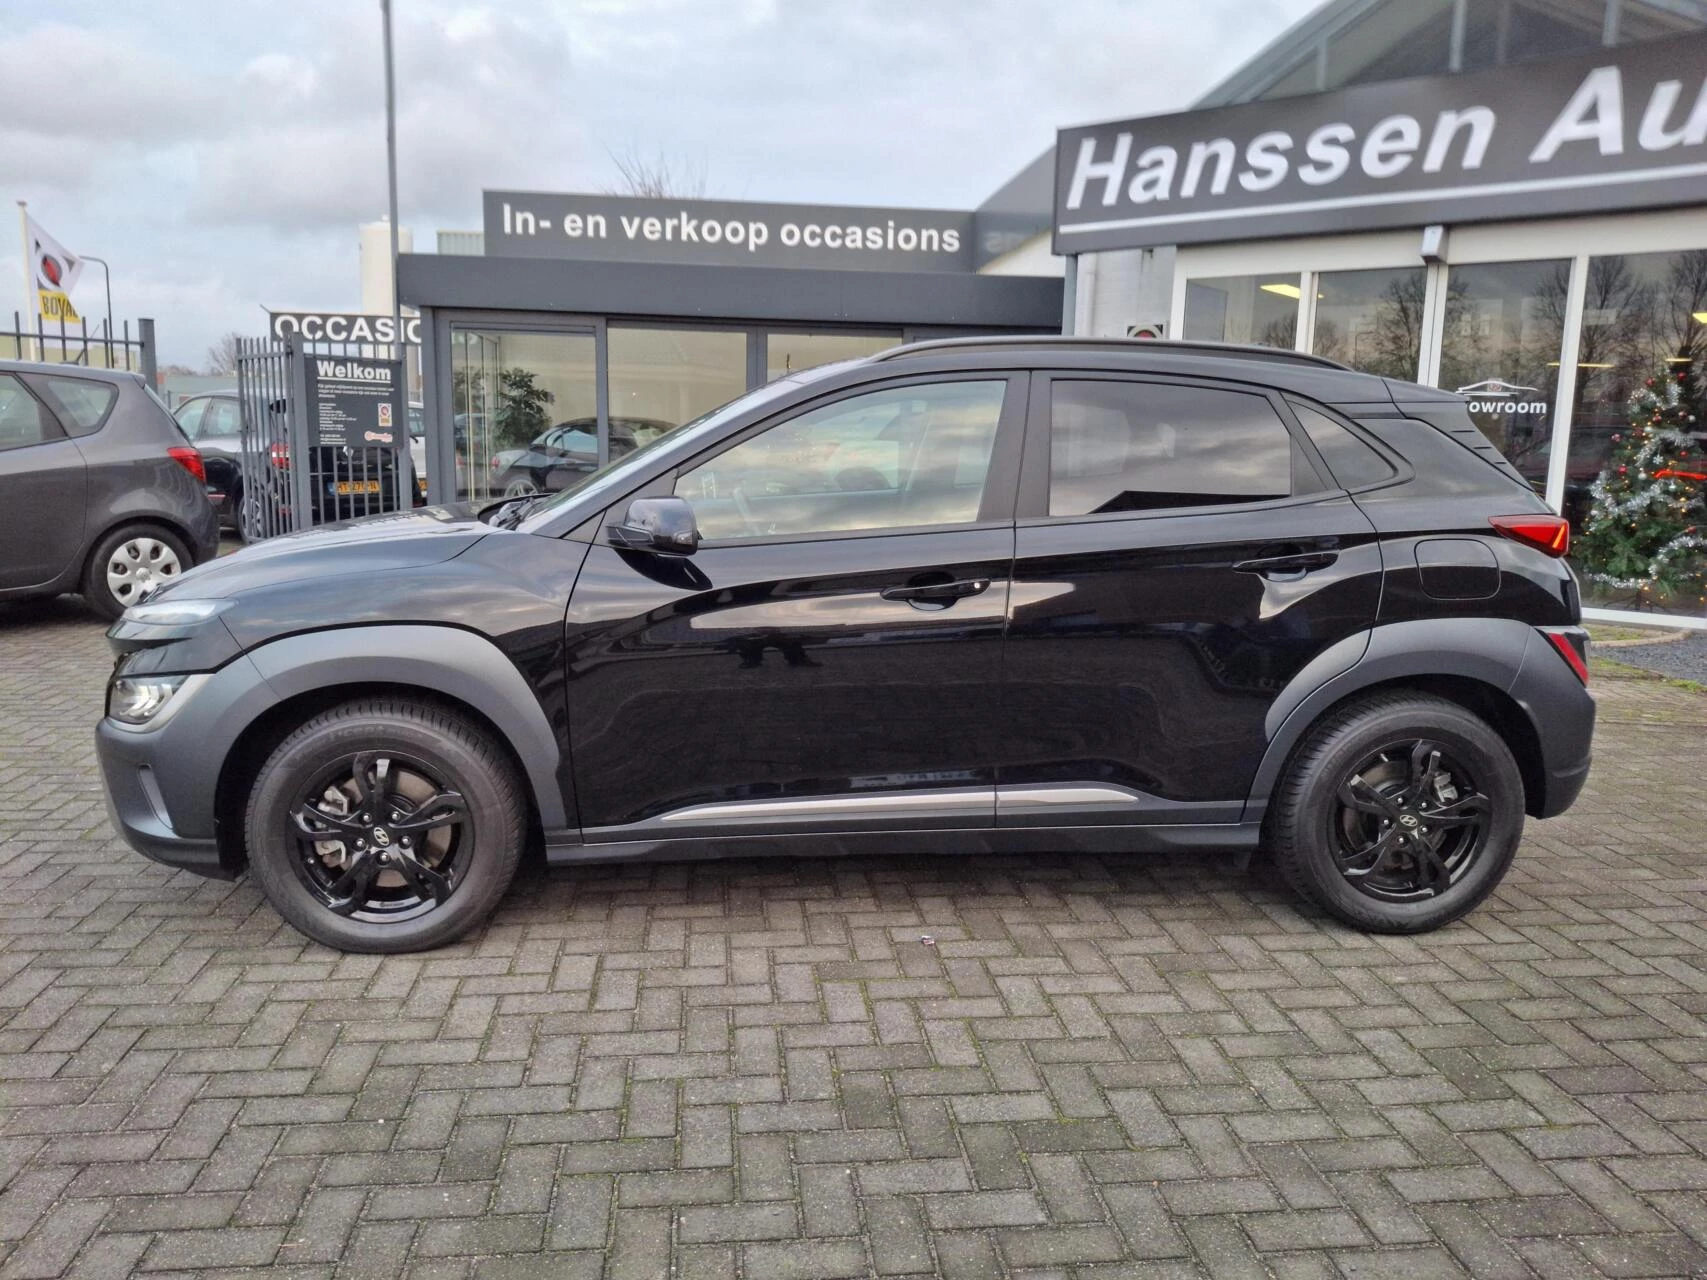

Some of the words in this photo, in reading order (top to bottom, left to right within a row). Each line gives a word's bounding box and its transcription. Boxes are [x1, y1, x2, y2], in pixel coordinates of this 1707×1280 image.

[1066, 104, 1497, 210] Hanssen
[1528, 65, 1707, 164] Au
[503, 203, 551, 235] In-
[563, 213, 607, 238] en
[620, 210, 768, 252] verkoop
[780, 220, 961, 252] occasions
[316, 360, 391, 380] Welkom
[1468, 401, 1547, 414] owroom
